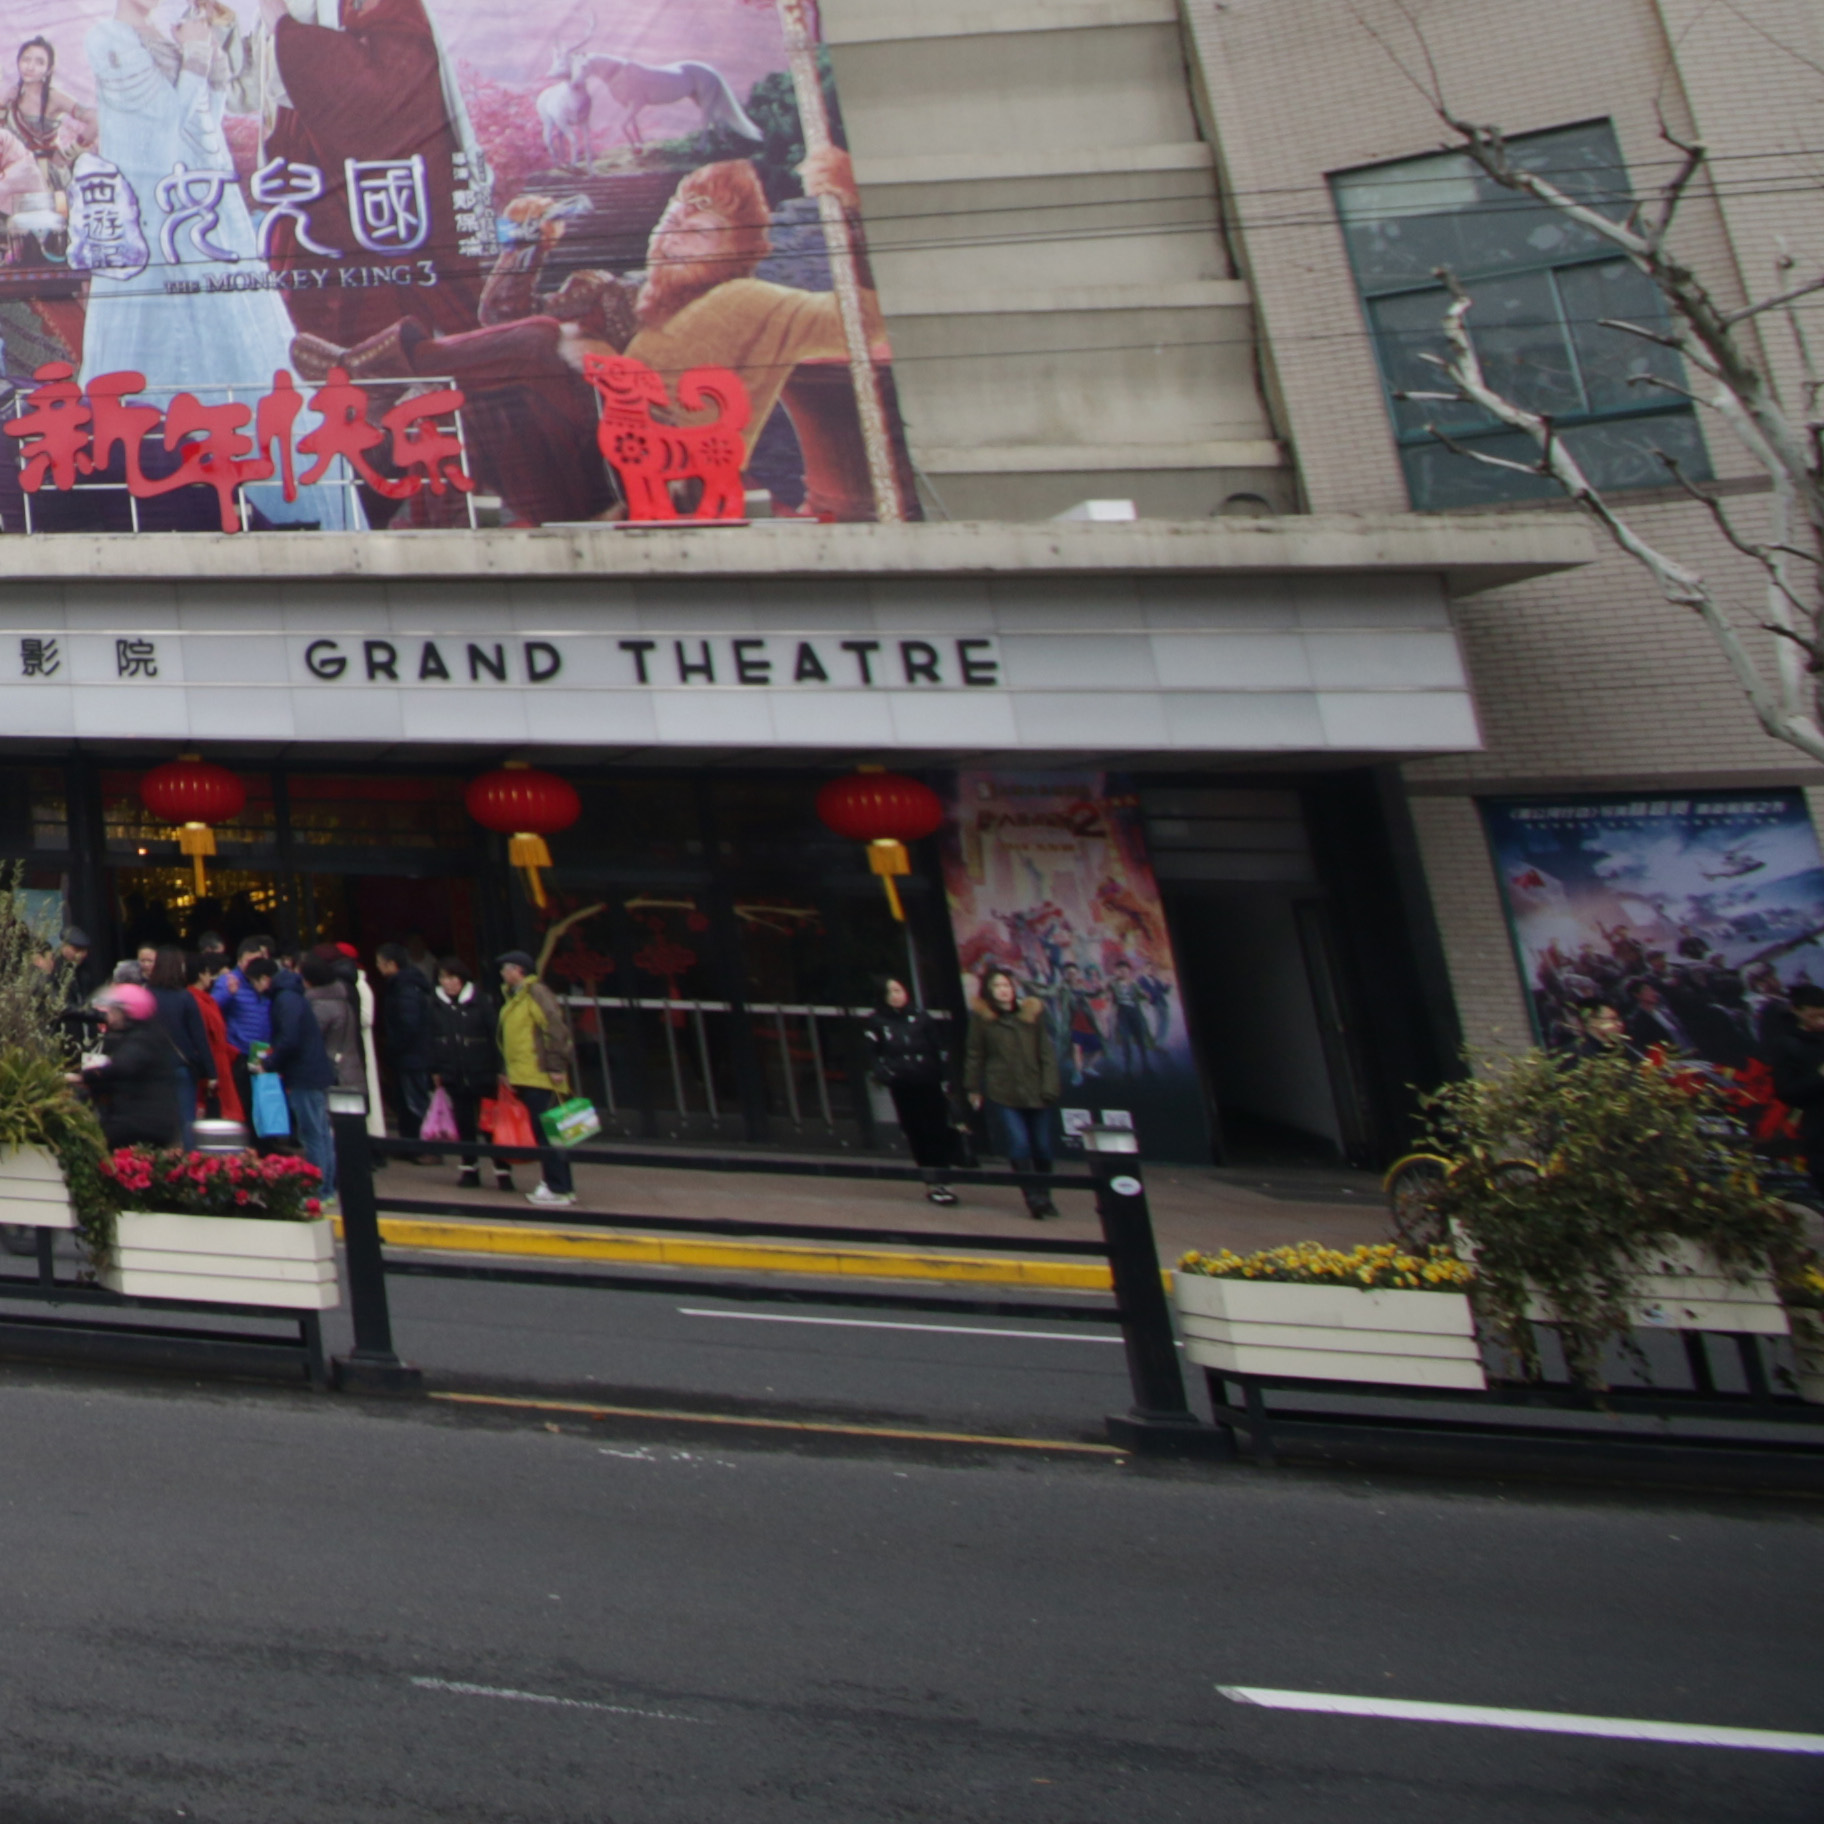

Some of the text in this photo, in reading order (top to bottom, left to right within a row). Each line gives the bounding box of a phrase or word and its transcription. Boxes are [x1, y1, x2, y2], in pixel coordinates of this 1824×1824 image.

[155, 156, 432, 264] 女兒國
[204, 269, 328, 293] MONKEY
[338, 265, 411, 288] KING
[416, 260, 437, 287] 3
[3, 361, 475, 533] 新年快乐
[305, 638, 1000, 687] GRAND THEATRE
